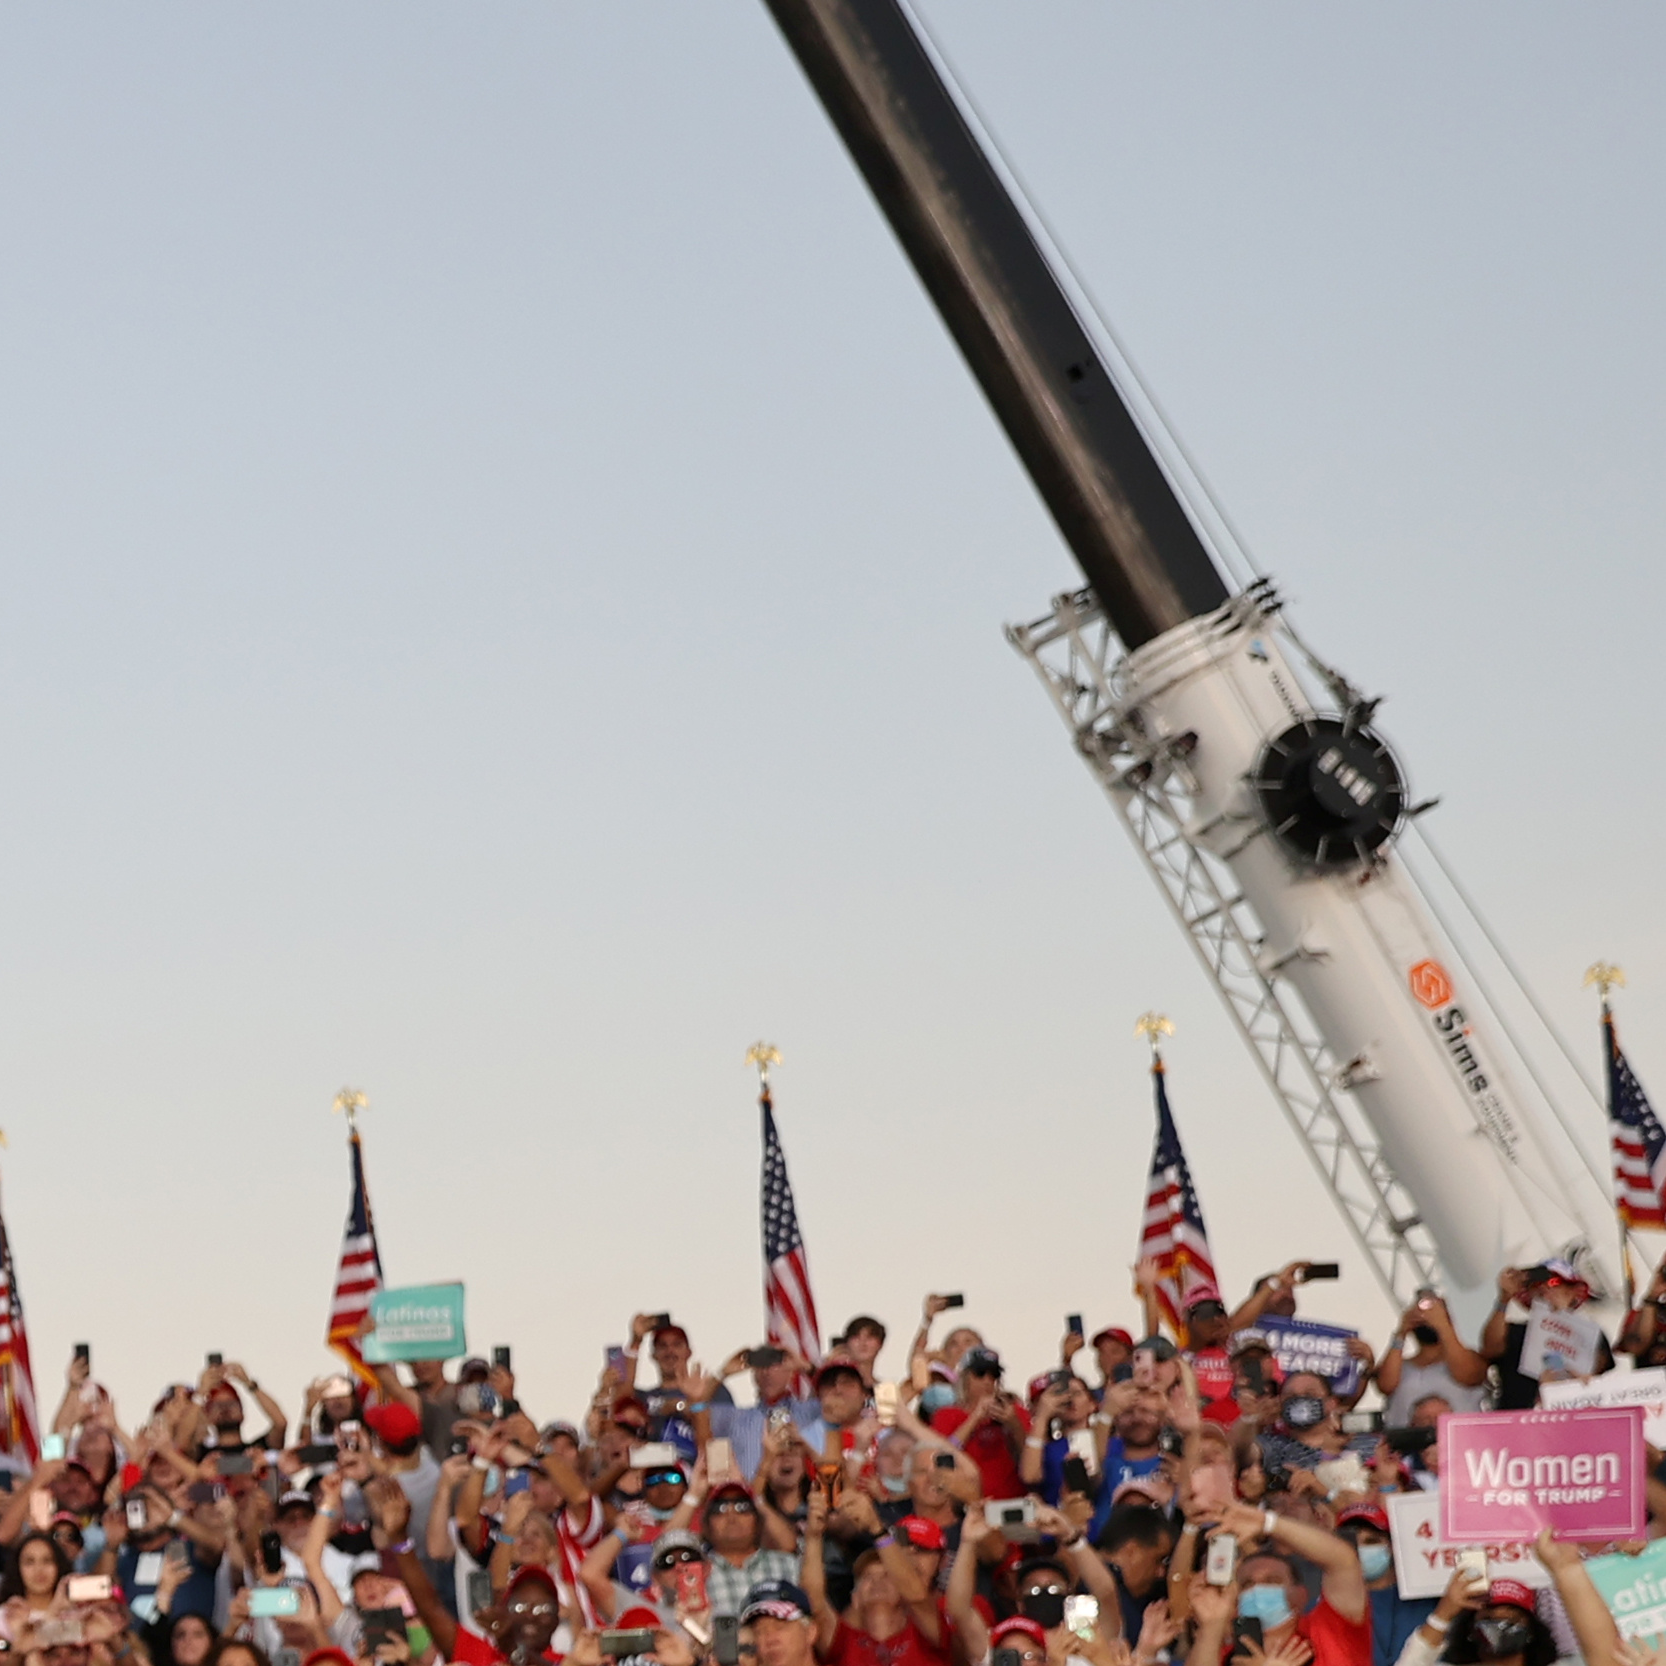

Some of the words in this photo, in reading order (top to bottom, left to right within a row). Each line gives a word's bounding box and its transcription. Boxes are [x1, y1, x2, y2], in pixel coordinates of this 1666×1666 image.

[1434, 1007, 1489, 1094] Sims
[1464, 1447, 1620, 1488] Women
[1482, 1488, 1529, 1506] FOR
[1534, 1486, 1607, 1504] TRUMP
[1416, 1521, 1433, 1540] 4
